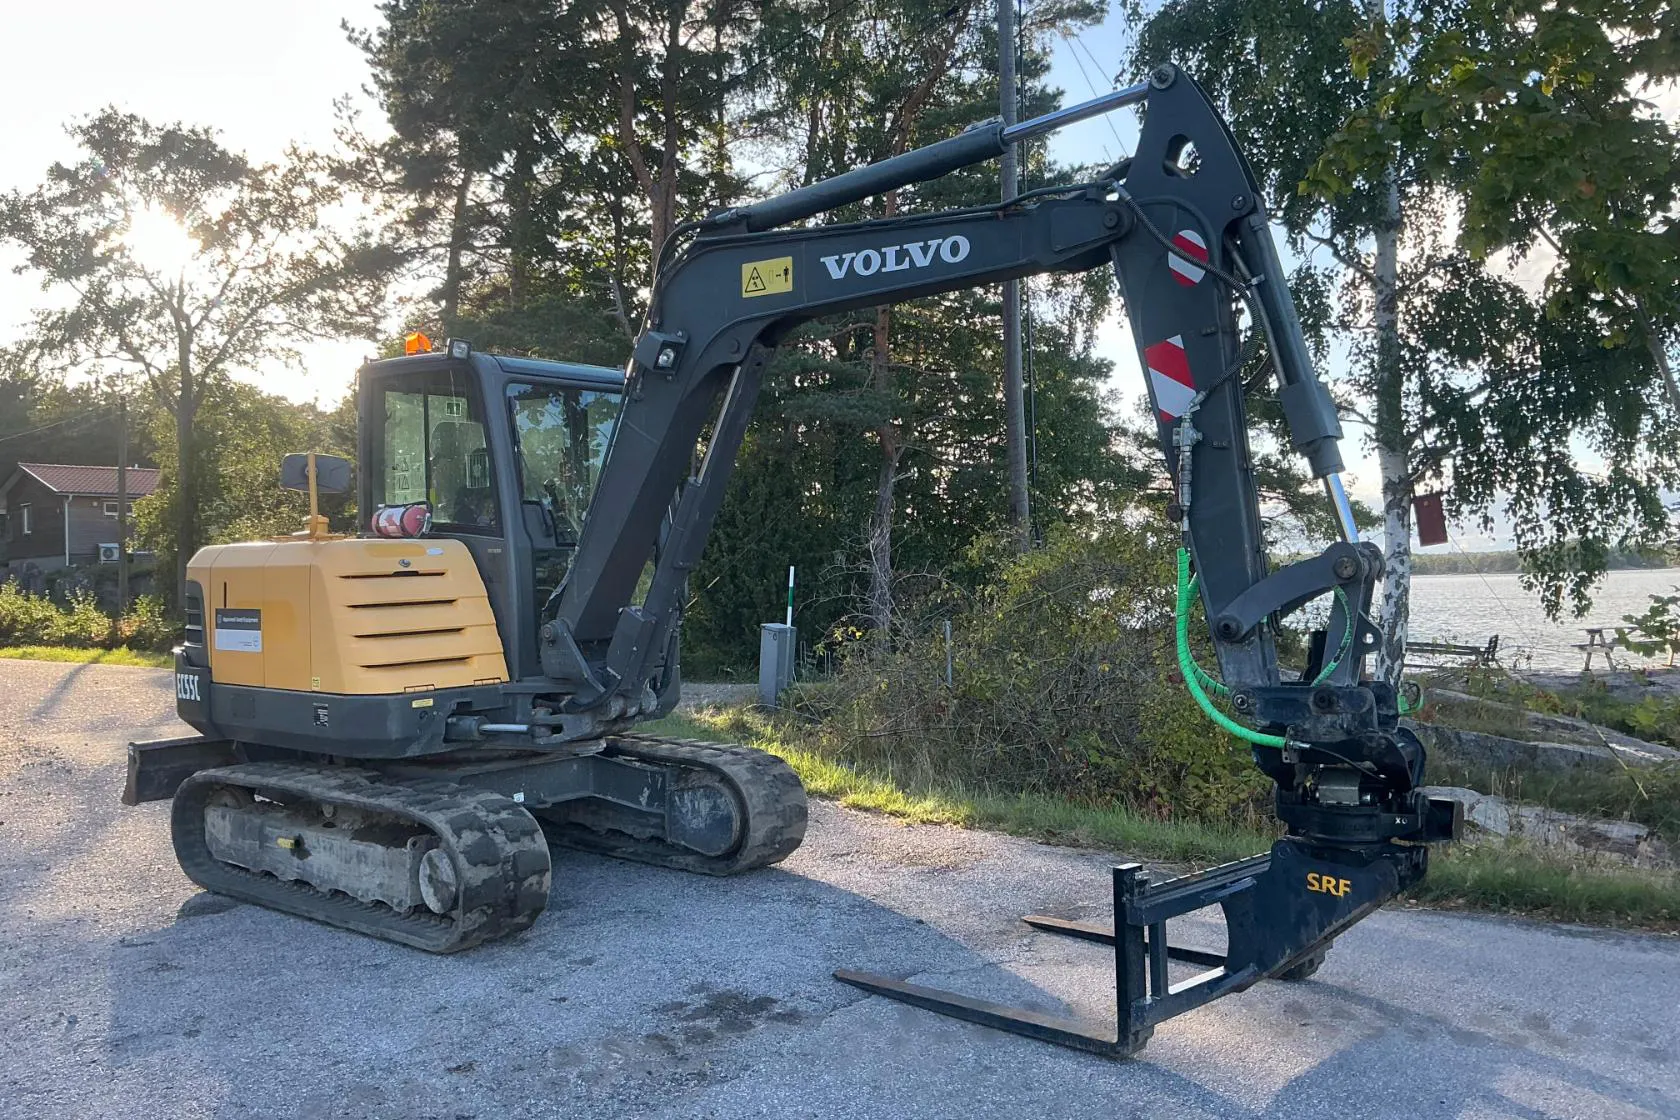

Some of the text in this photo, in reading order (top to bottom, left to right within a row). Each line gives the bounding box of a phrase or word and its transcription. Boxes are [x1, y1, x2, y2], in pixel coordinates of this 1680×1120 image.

[820, 235, 970, 279] VOLVO
[177, 673, 201, 701] EC55C
[1306, 873, 1352, 896] SRF
